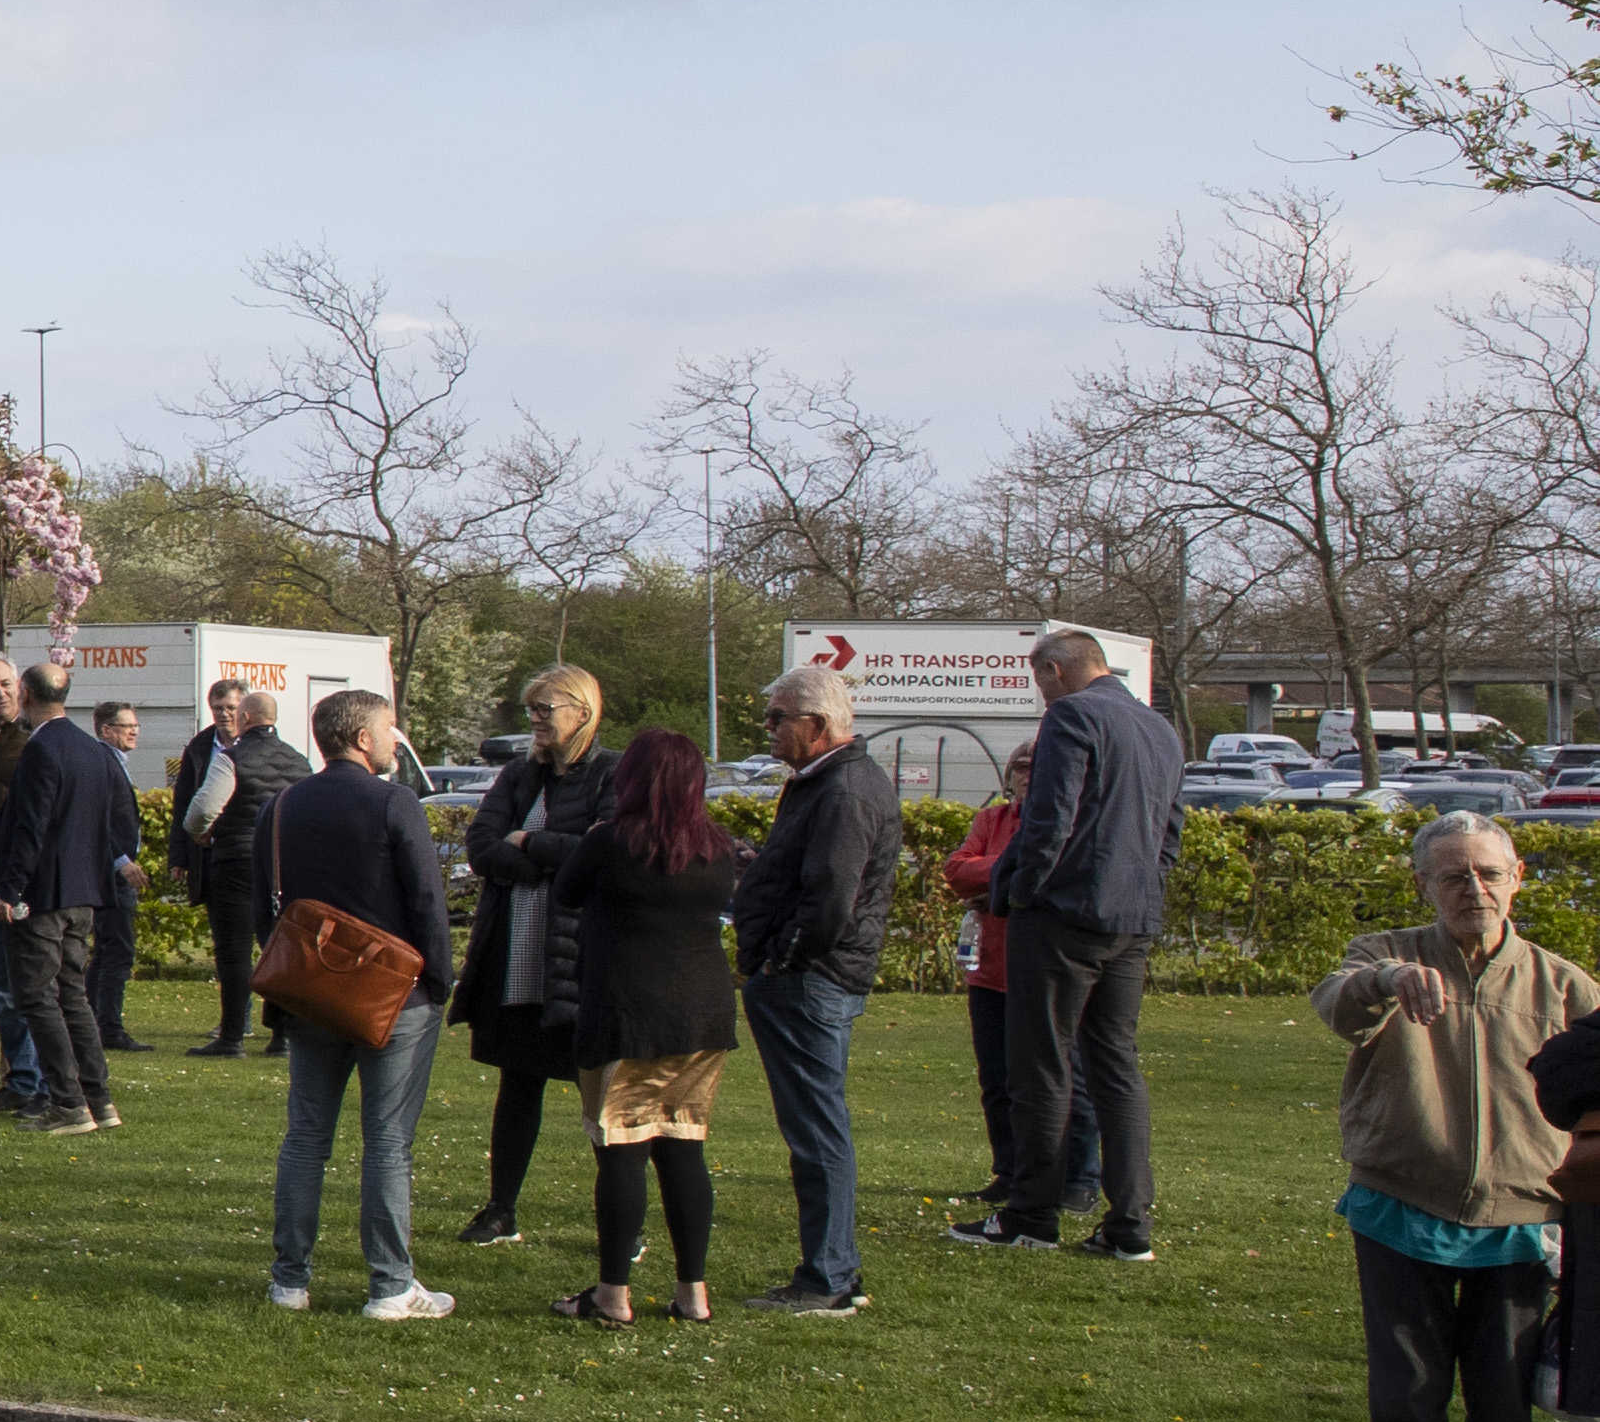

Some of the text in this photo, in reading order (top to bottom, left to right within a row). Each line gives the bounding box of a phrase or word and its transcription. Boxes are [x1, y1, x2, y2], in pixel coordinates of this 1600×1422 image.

[78, 646, 148, 668] TRANS
[865, 654, 1031, 669] HR TRANSPORT
[241, 664, 287, 692] TRANS
[865, 674, 1029, 688] KOMPAGNIET B2B
[874, 696, 1034, 705] HRTRANSPORTKOMPAGNIET.DK
